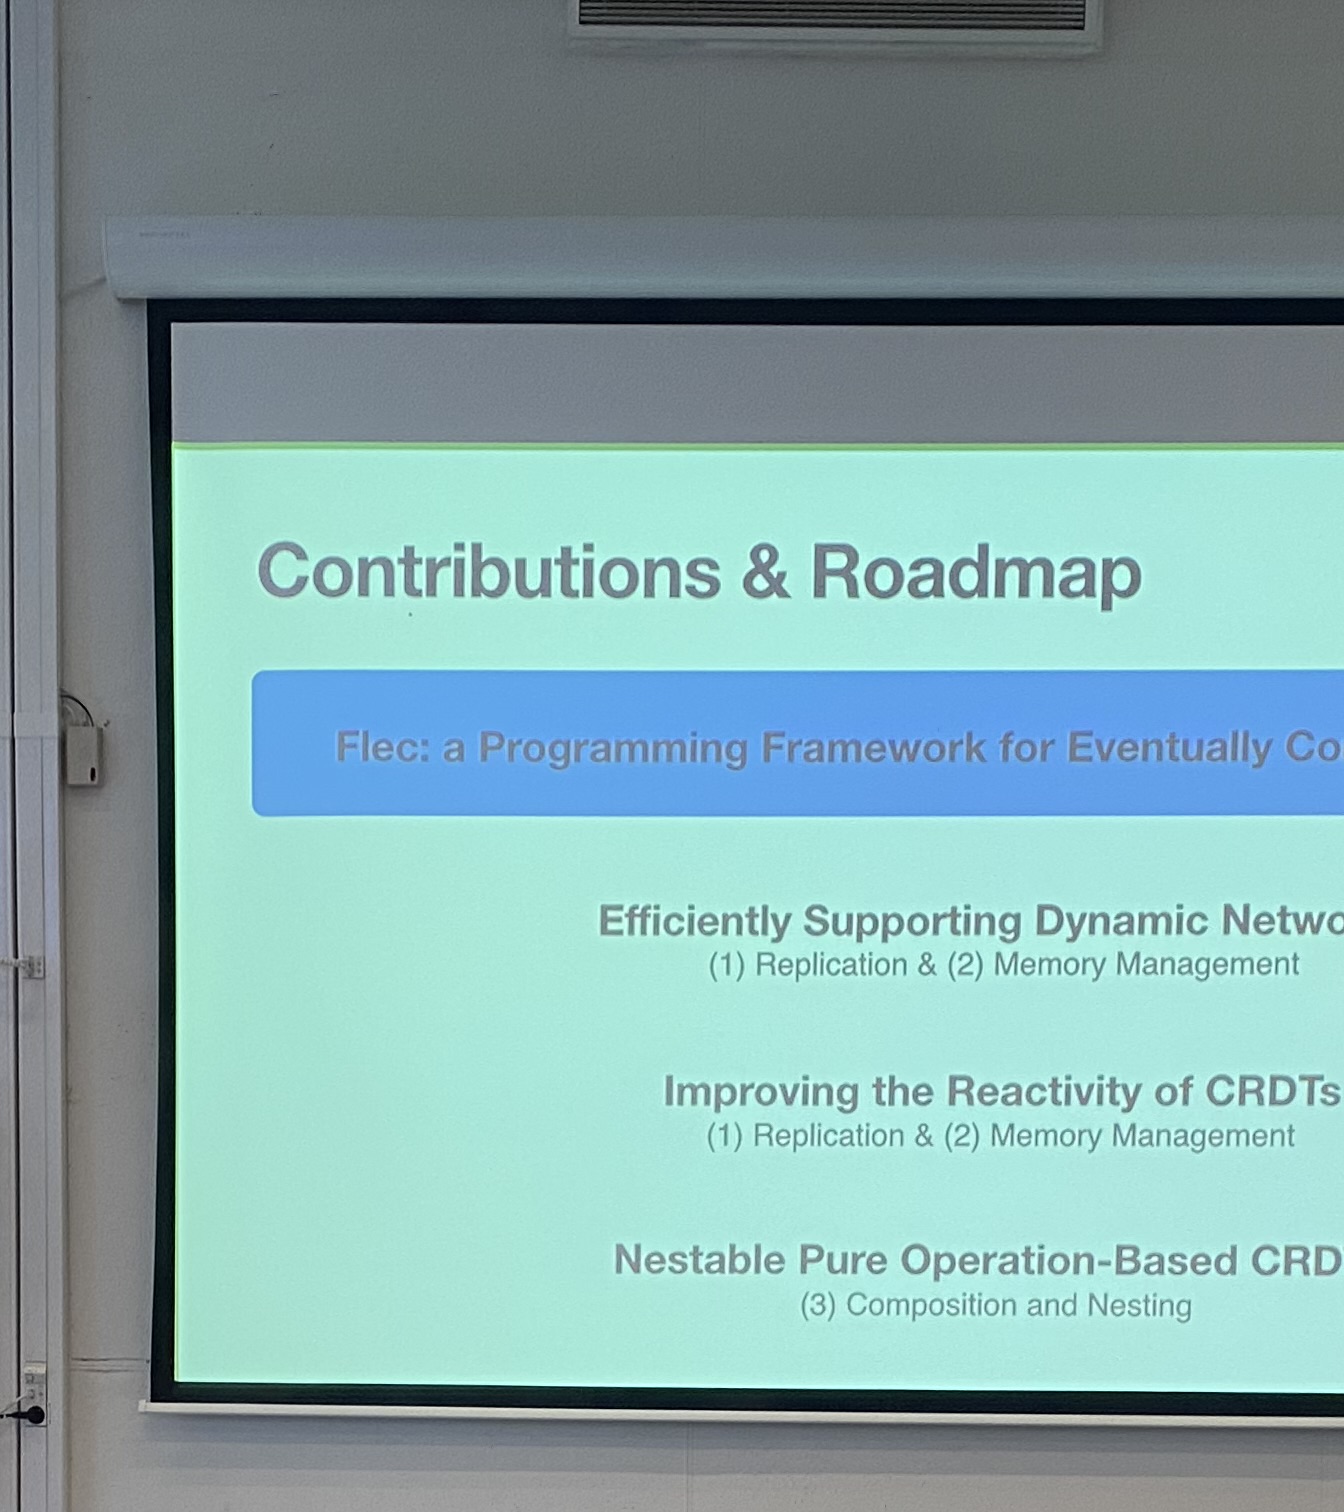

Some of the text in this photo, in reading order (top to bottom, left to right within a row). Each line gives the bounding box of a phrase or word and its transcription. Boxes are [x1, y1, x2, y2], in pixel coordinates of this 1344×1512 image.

[258, 540, 1142, 613] Contributions & Roadmap
[337, 730, 429, 762] Flec:
[444, 740, 464, 762] a
[481, 731, 748, 771] Programming
[763, 730, 988, 763] Framework
[999, 730, 1056, 763] for
[1069, 729, 1274, 769] Eventually
[600, 903, 793, 944] Efficiently
[803, 903, 1022, 945] Supporting
[1036, 903, 1209, 944] Dynamic
[709, 950, 1300, 983] (1) Replication & (2) Memory Management
[665, 1073, 1342, 1115] Improving the Reactivity of CRDTs
[707, 1121, 1296, 1155] (1) Replication & (2) Memory Management
[615, 1243, 786, 1275] Nestable
[800, 1243, 888, 1275] Pure
[901, 1243, 1238, 1283] Operation-Based
[801, 1290, 1192, 1324] (3) Composition and Nesting
